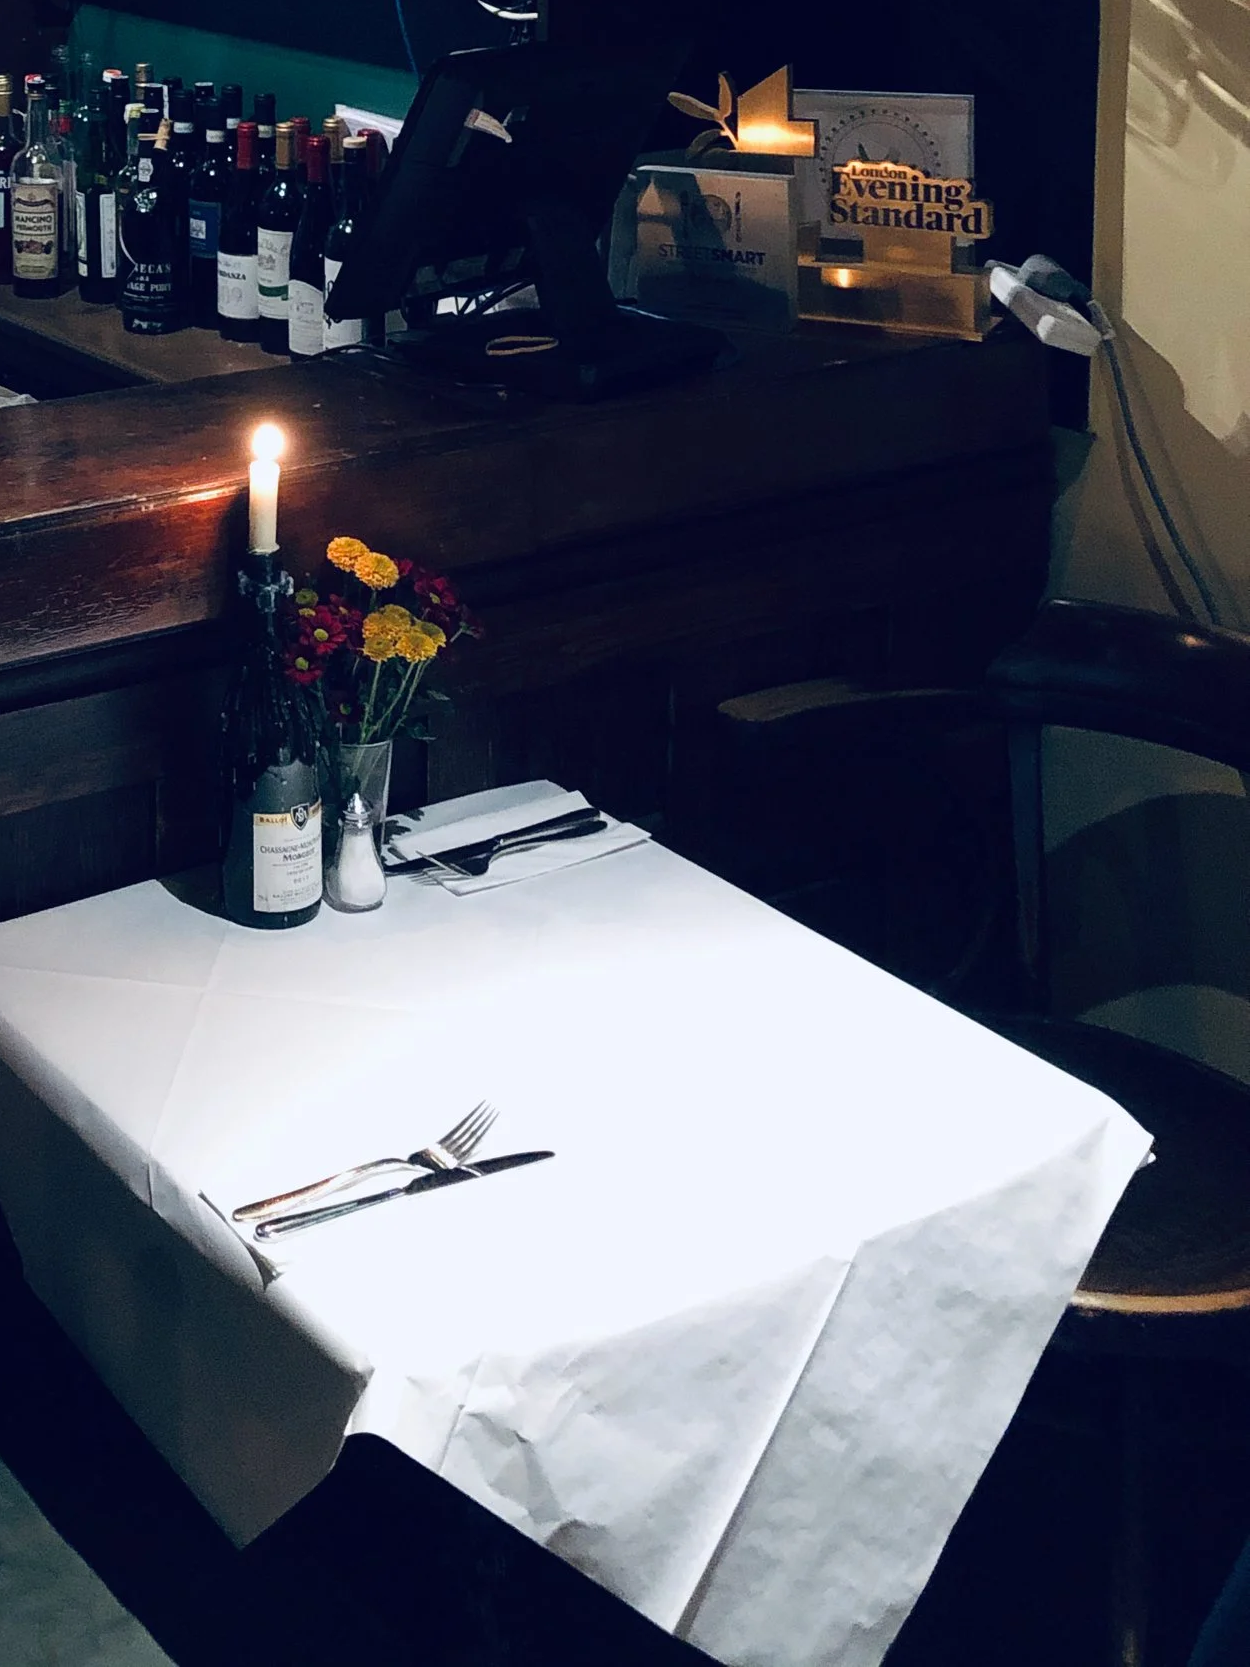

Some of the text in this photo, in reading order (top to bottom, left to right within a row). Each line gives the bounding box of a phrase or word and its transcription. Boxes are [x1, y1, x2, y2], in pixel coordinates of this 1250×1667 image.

[851, 165, 907, 180] London
[832, 172, 965, 211] Evening
[15, 215, 53, 224] MANCINO
[830, 197, 982, 234] Standard
[659, 244, 766, 266] STREETSMART
